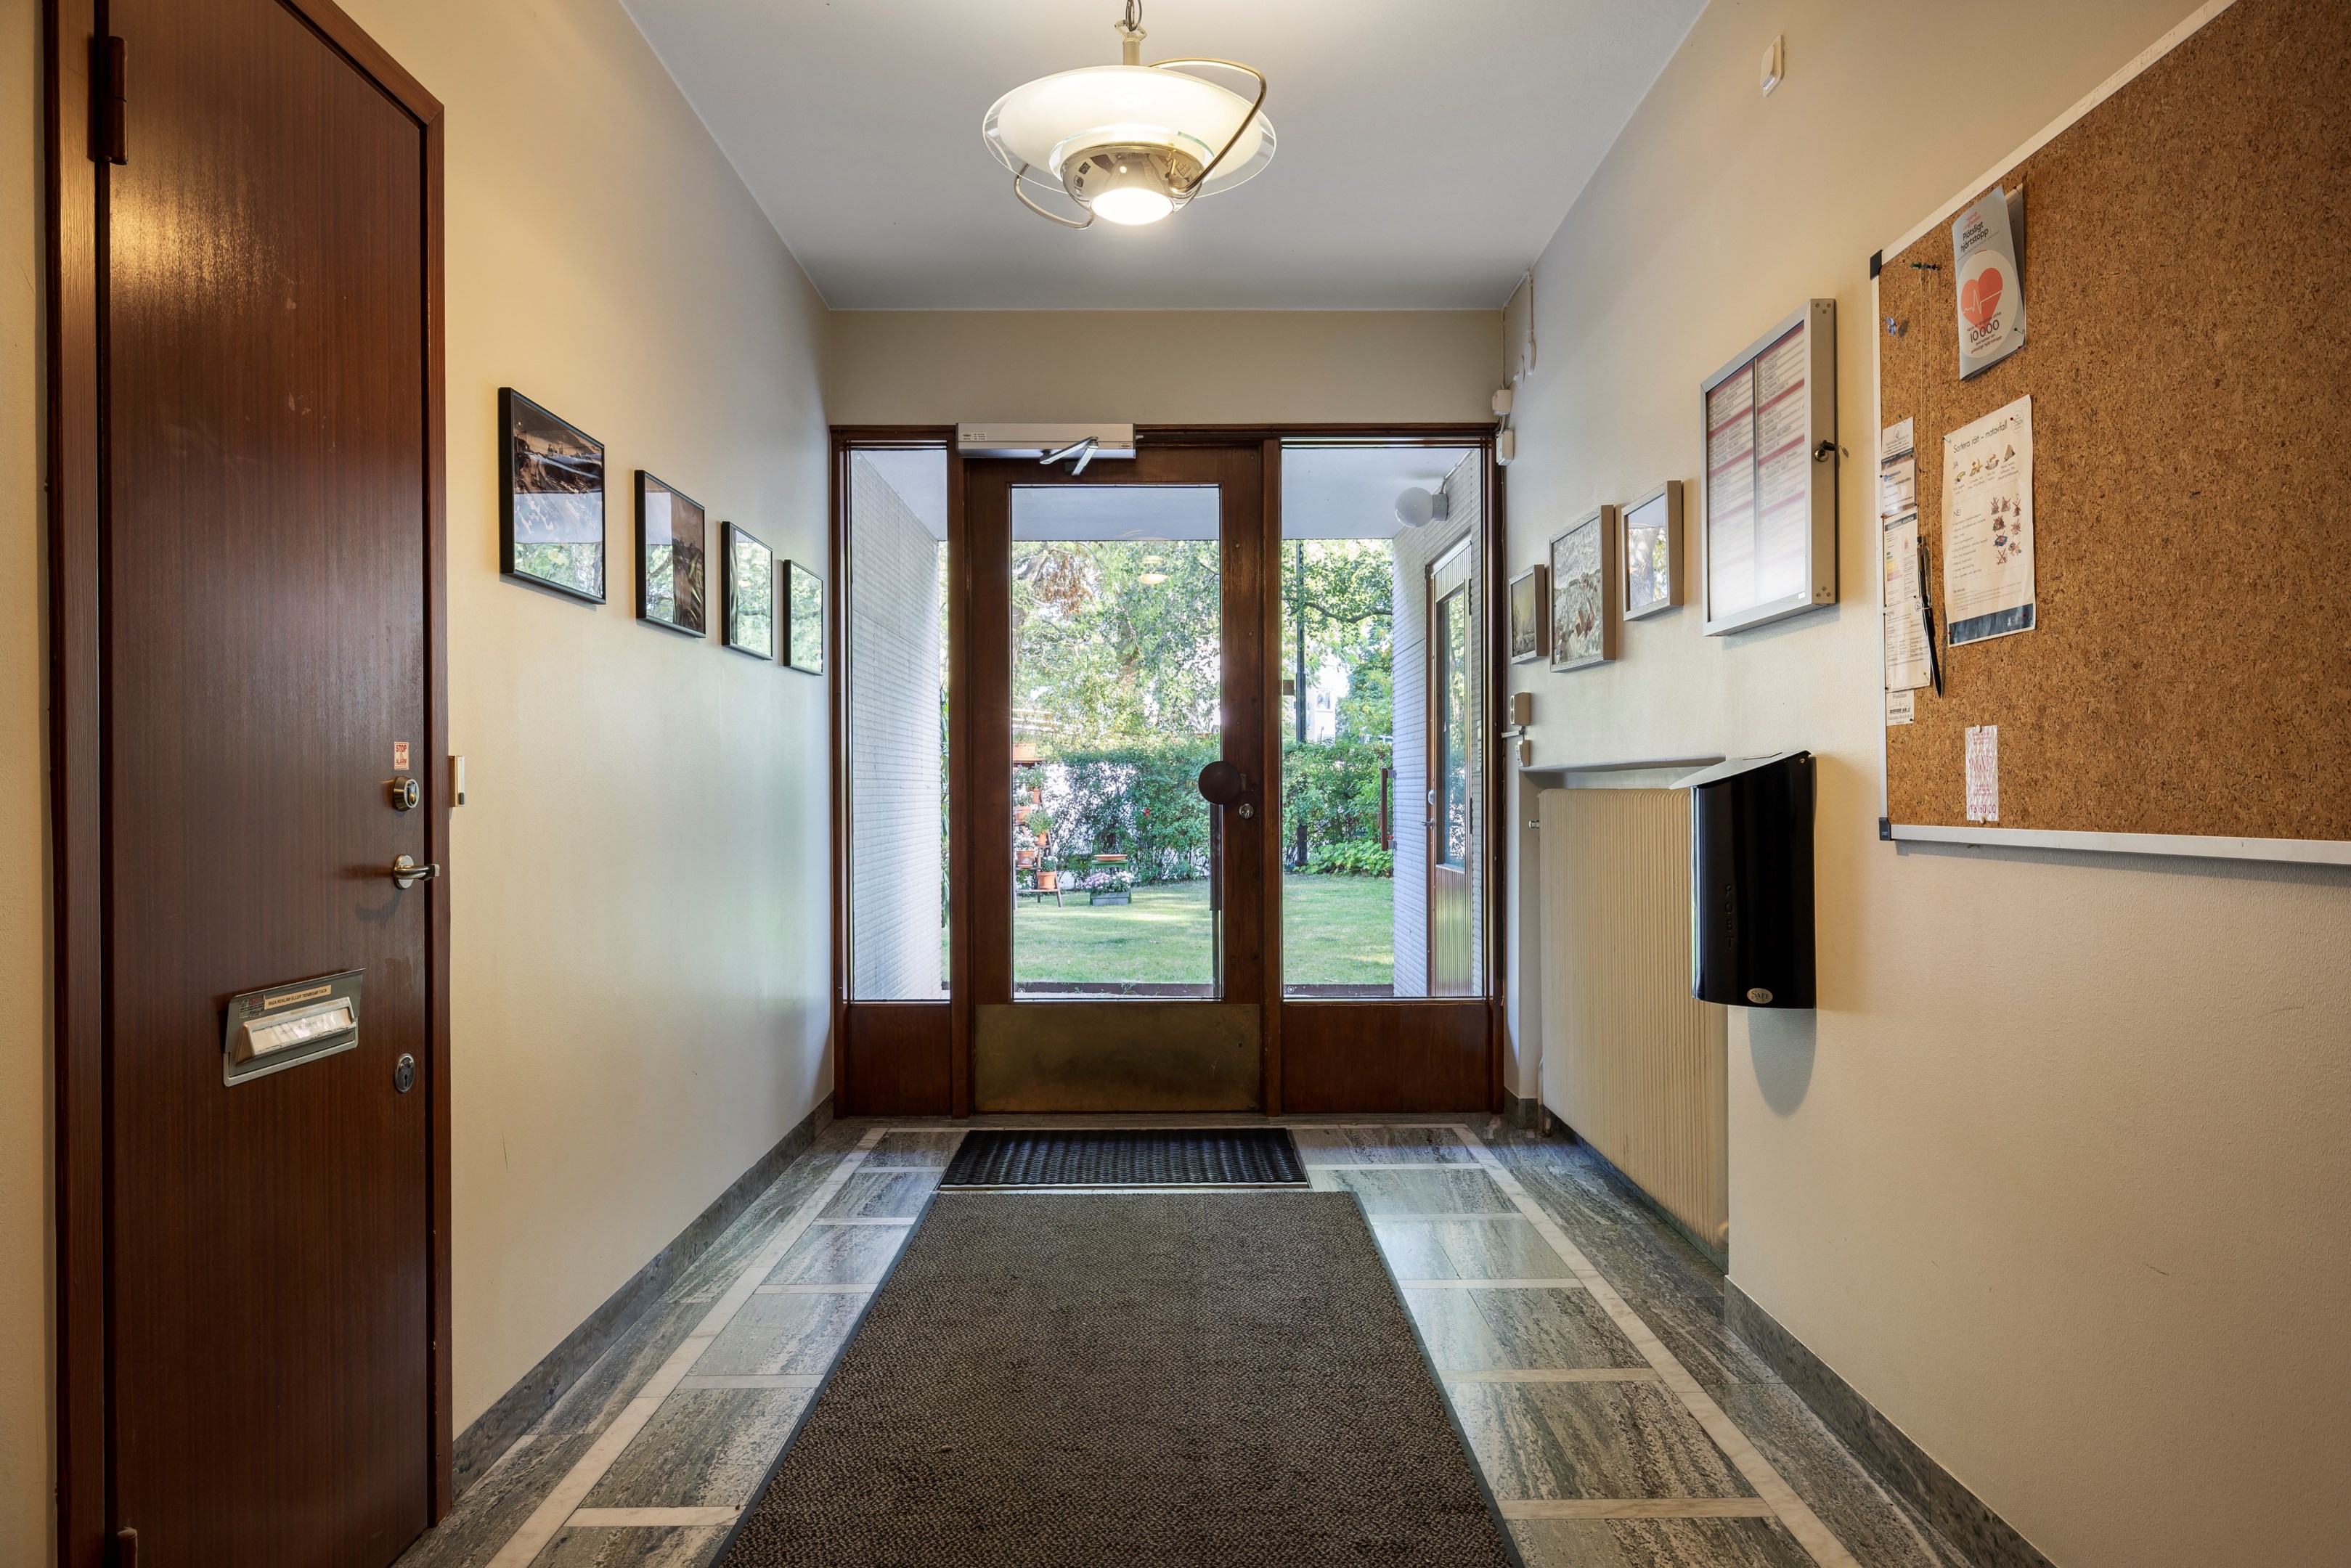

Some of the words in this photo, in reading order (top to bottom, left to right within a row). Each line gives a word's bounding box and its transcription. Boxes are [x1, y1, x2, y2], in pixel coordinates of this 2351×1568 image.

[1963, 221, 1984, 242] Plötsligt
[1960, 228, 1989, 253] hjärtstopp
[1970, 330, 1979, 343] 10
[1976, 336, 1991, 346] personer
[1984, 335, 2002, 347] hjärtstopp
[1953, 441, 1971, 454] Sortera
[1985, 420, 2008, 439] matavfall
[1952, 461, 1959, 470] JA
[396, 744, 407, 753] STOP
[1725, 883, 1735, 950] POST
[302, 990, 319, 999] TIDNINGAR
[1751, 990, 1770, 999] SAFE
